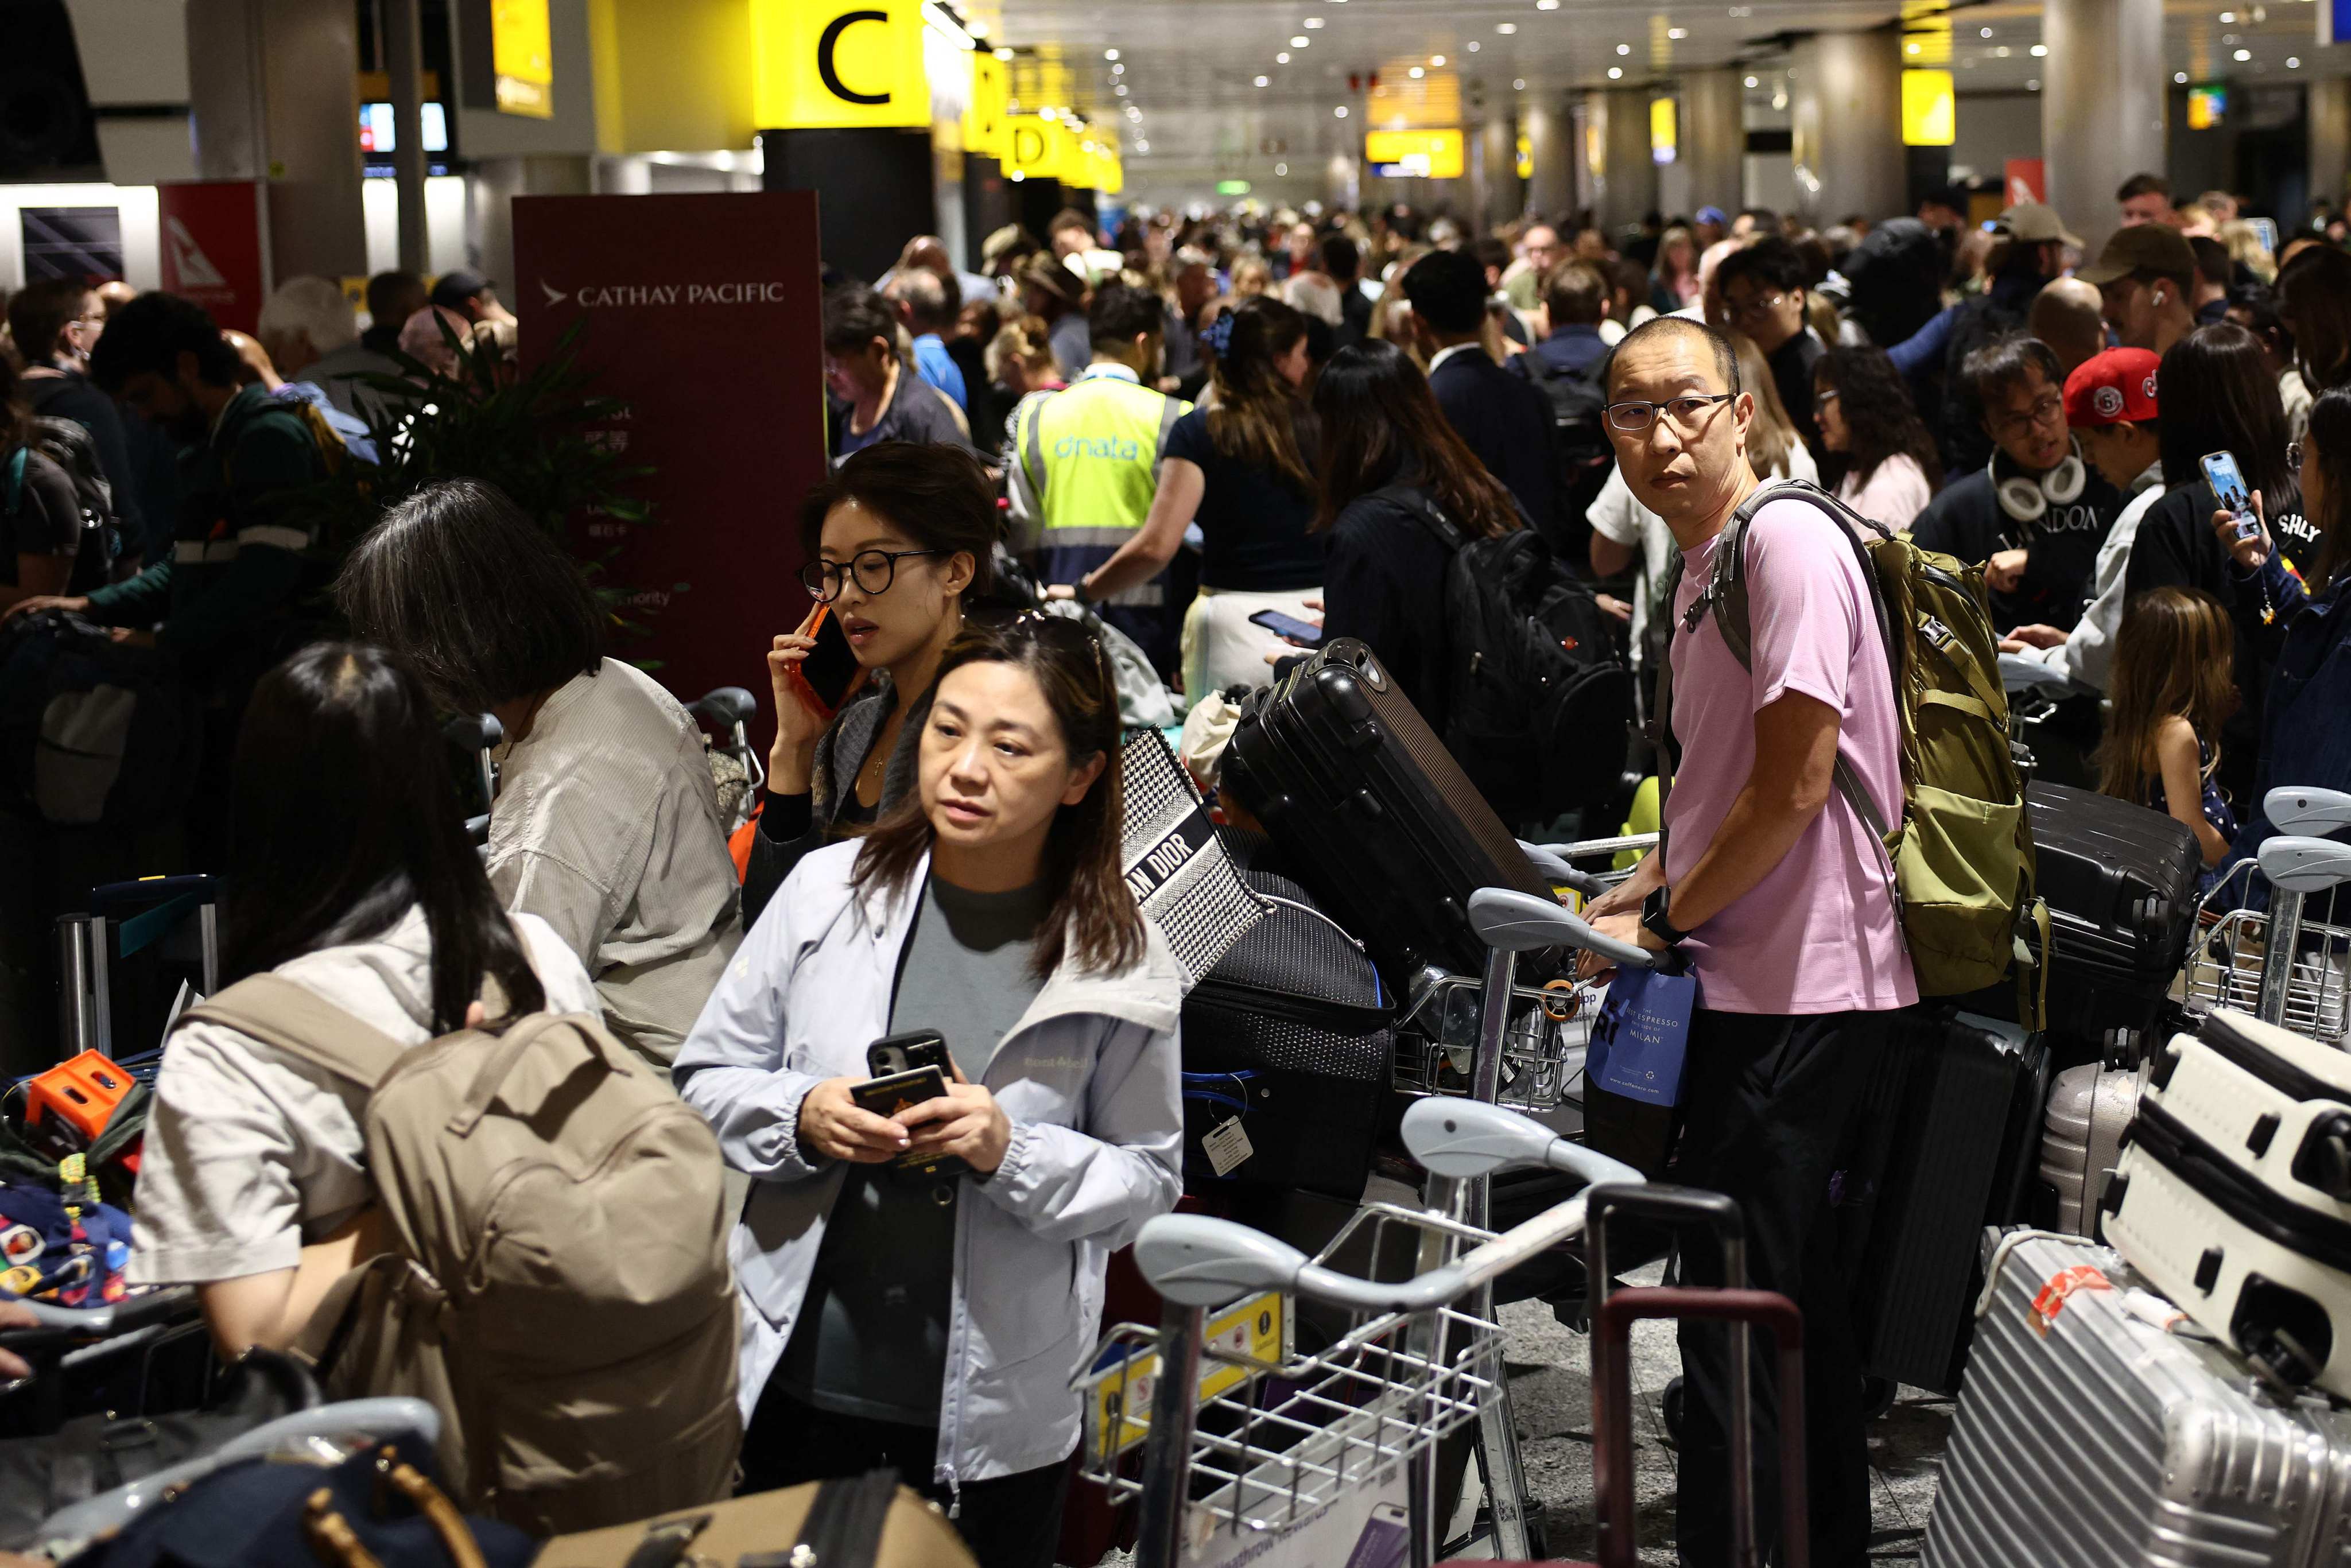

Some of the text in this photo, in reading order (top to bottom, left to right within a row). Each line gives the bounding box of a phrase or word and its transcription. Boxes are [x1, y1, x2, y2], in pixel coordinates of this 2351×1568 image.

[817, 10, 891, 104] C
[1015, 126, 1044, 165] D
[577, 281, 784, 308] CATHAY PACIFIC
[1055, 434, 1138, 460] dnata
[1147, 833, 1194, 879] DIOR
[1638, 1013, 1678, 1027] ESPRESSO
